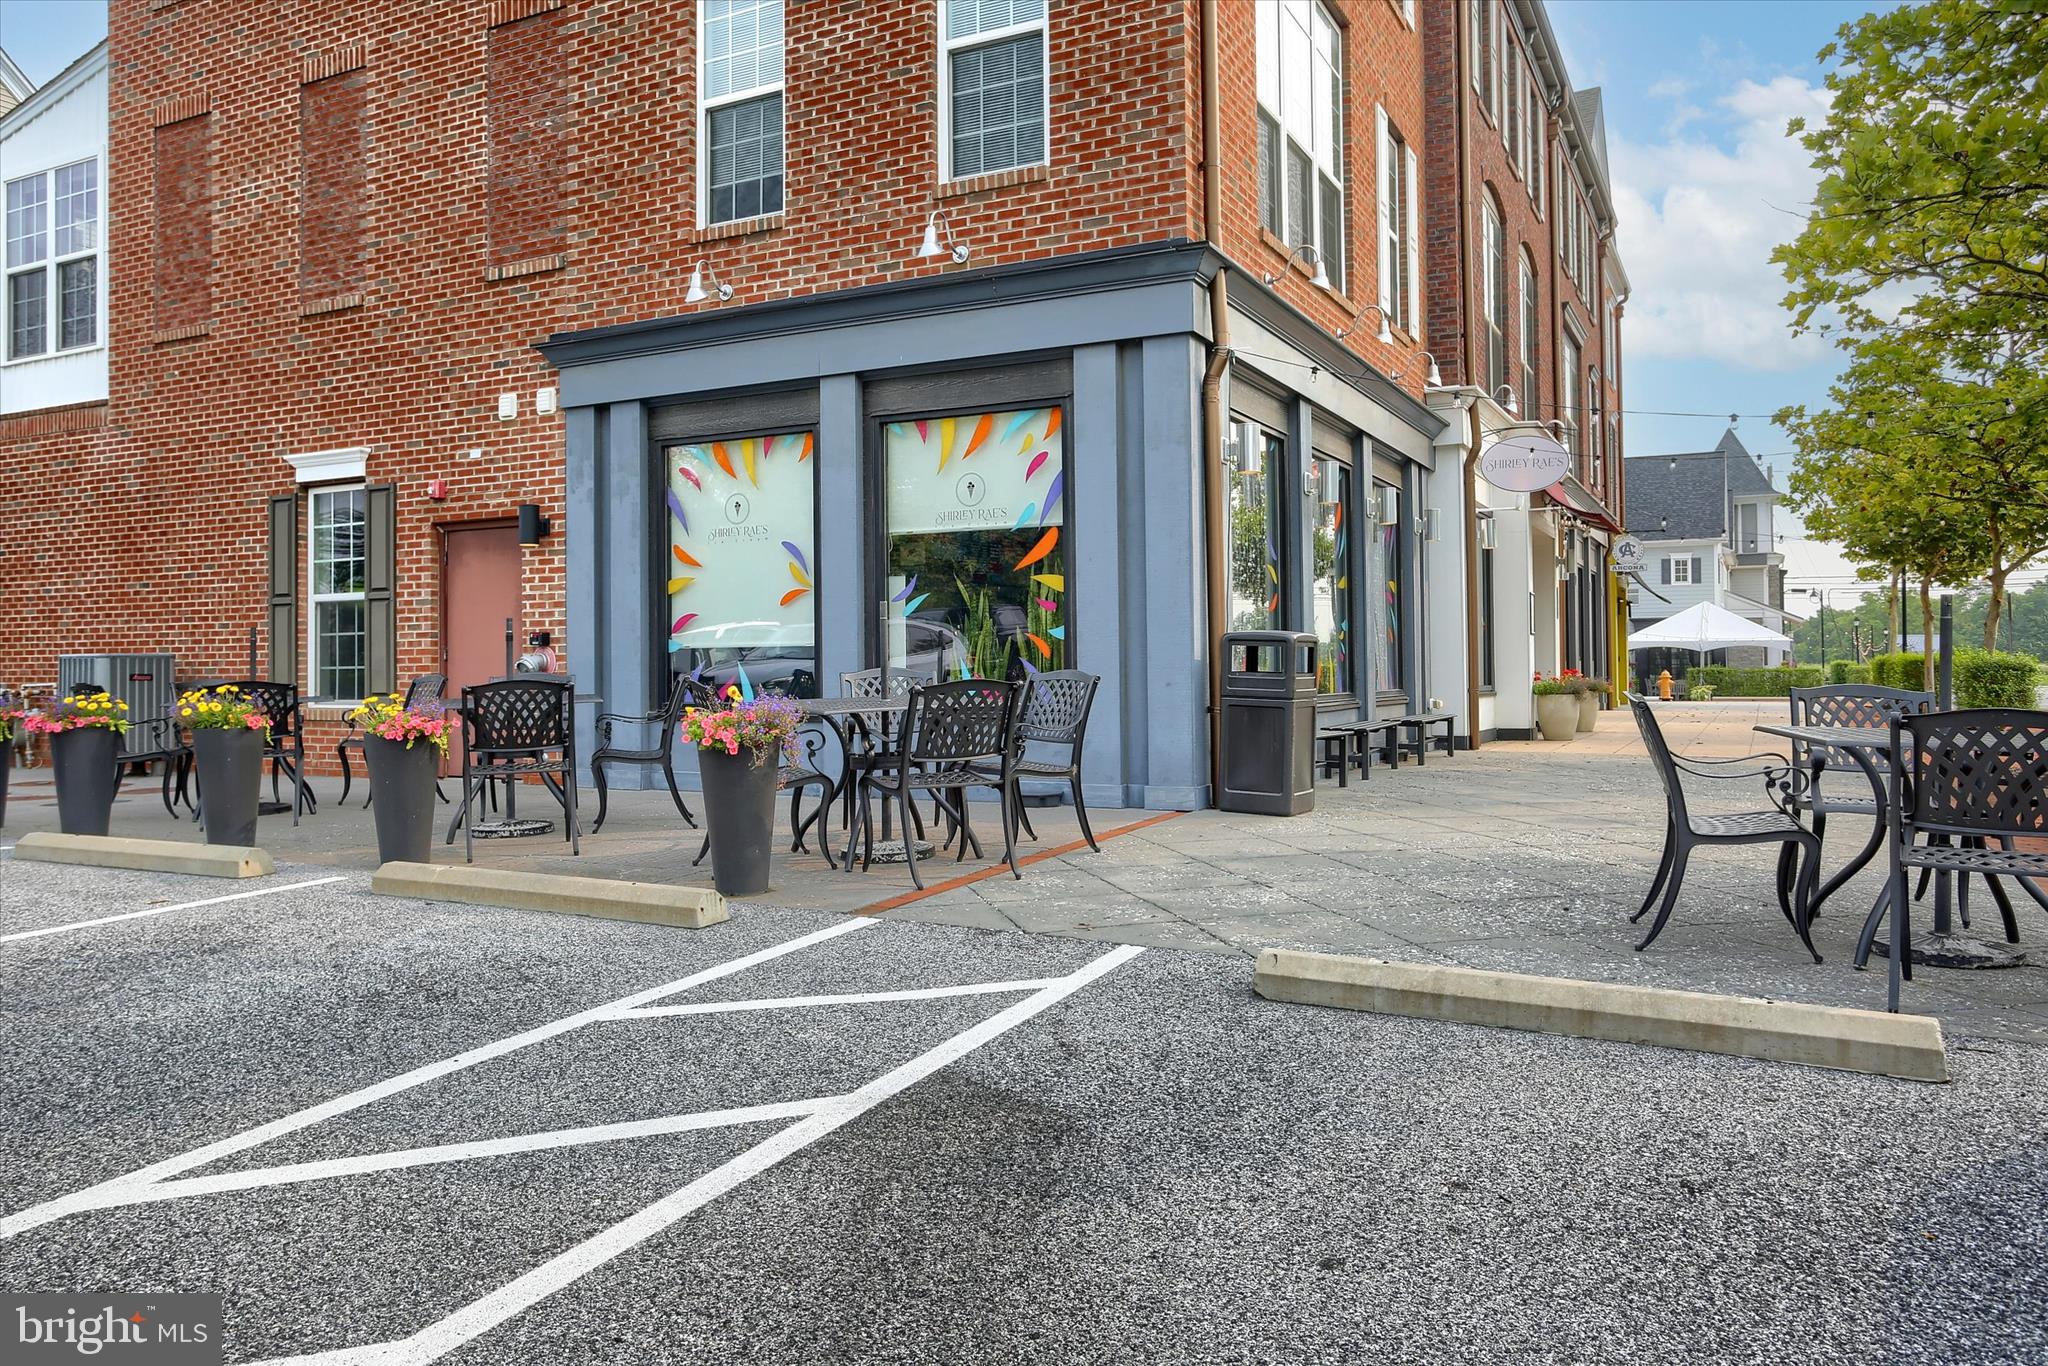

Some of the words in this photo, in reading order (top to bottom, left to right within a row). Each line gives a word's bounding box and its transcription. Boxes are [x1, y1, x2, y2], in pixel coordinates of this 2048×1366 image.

[1486, 458, 1529, 472] SHIRLEY
[1532, 457, 1564, 470] RAE'S
[935, 509, 975, 526] SHIRLEY
[978, 507, 1008, 521] RAE'S
[708, 526, 741, 541] SHIRLEY
[743, 524, 768, 538] RAE'S
